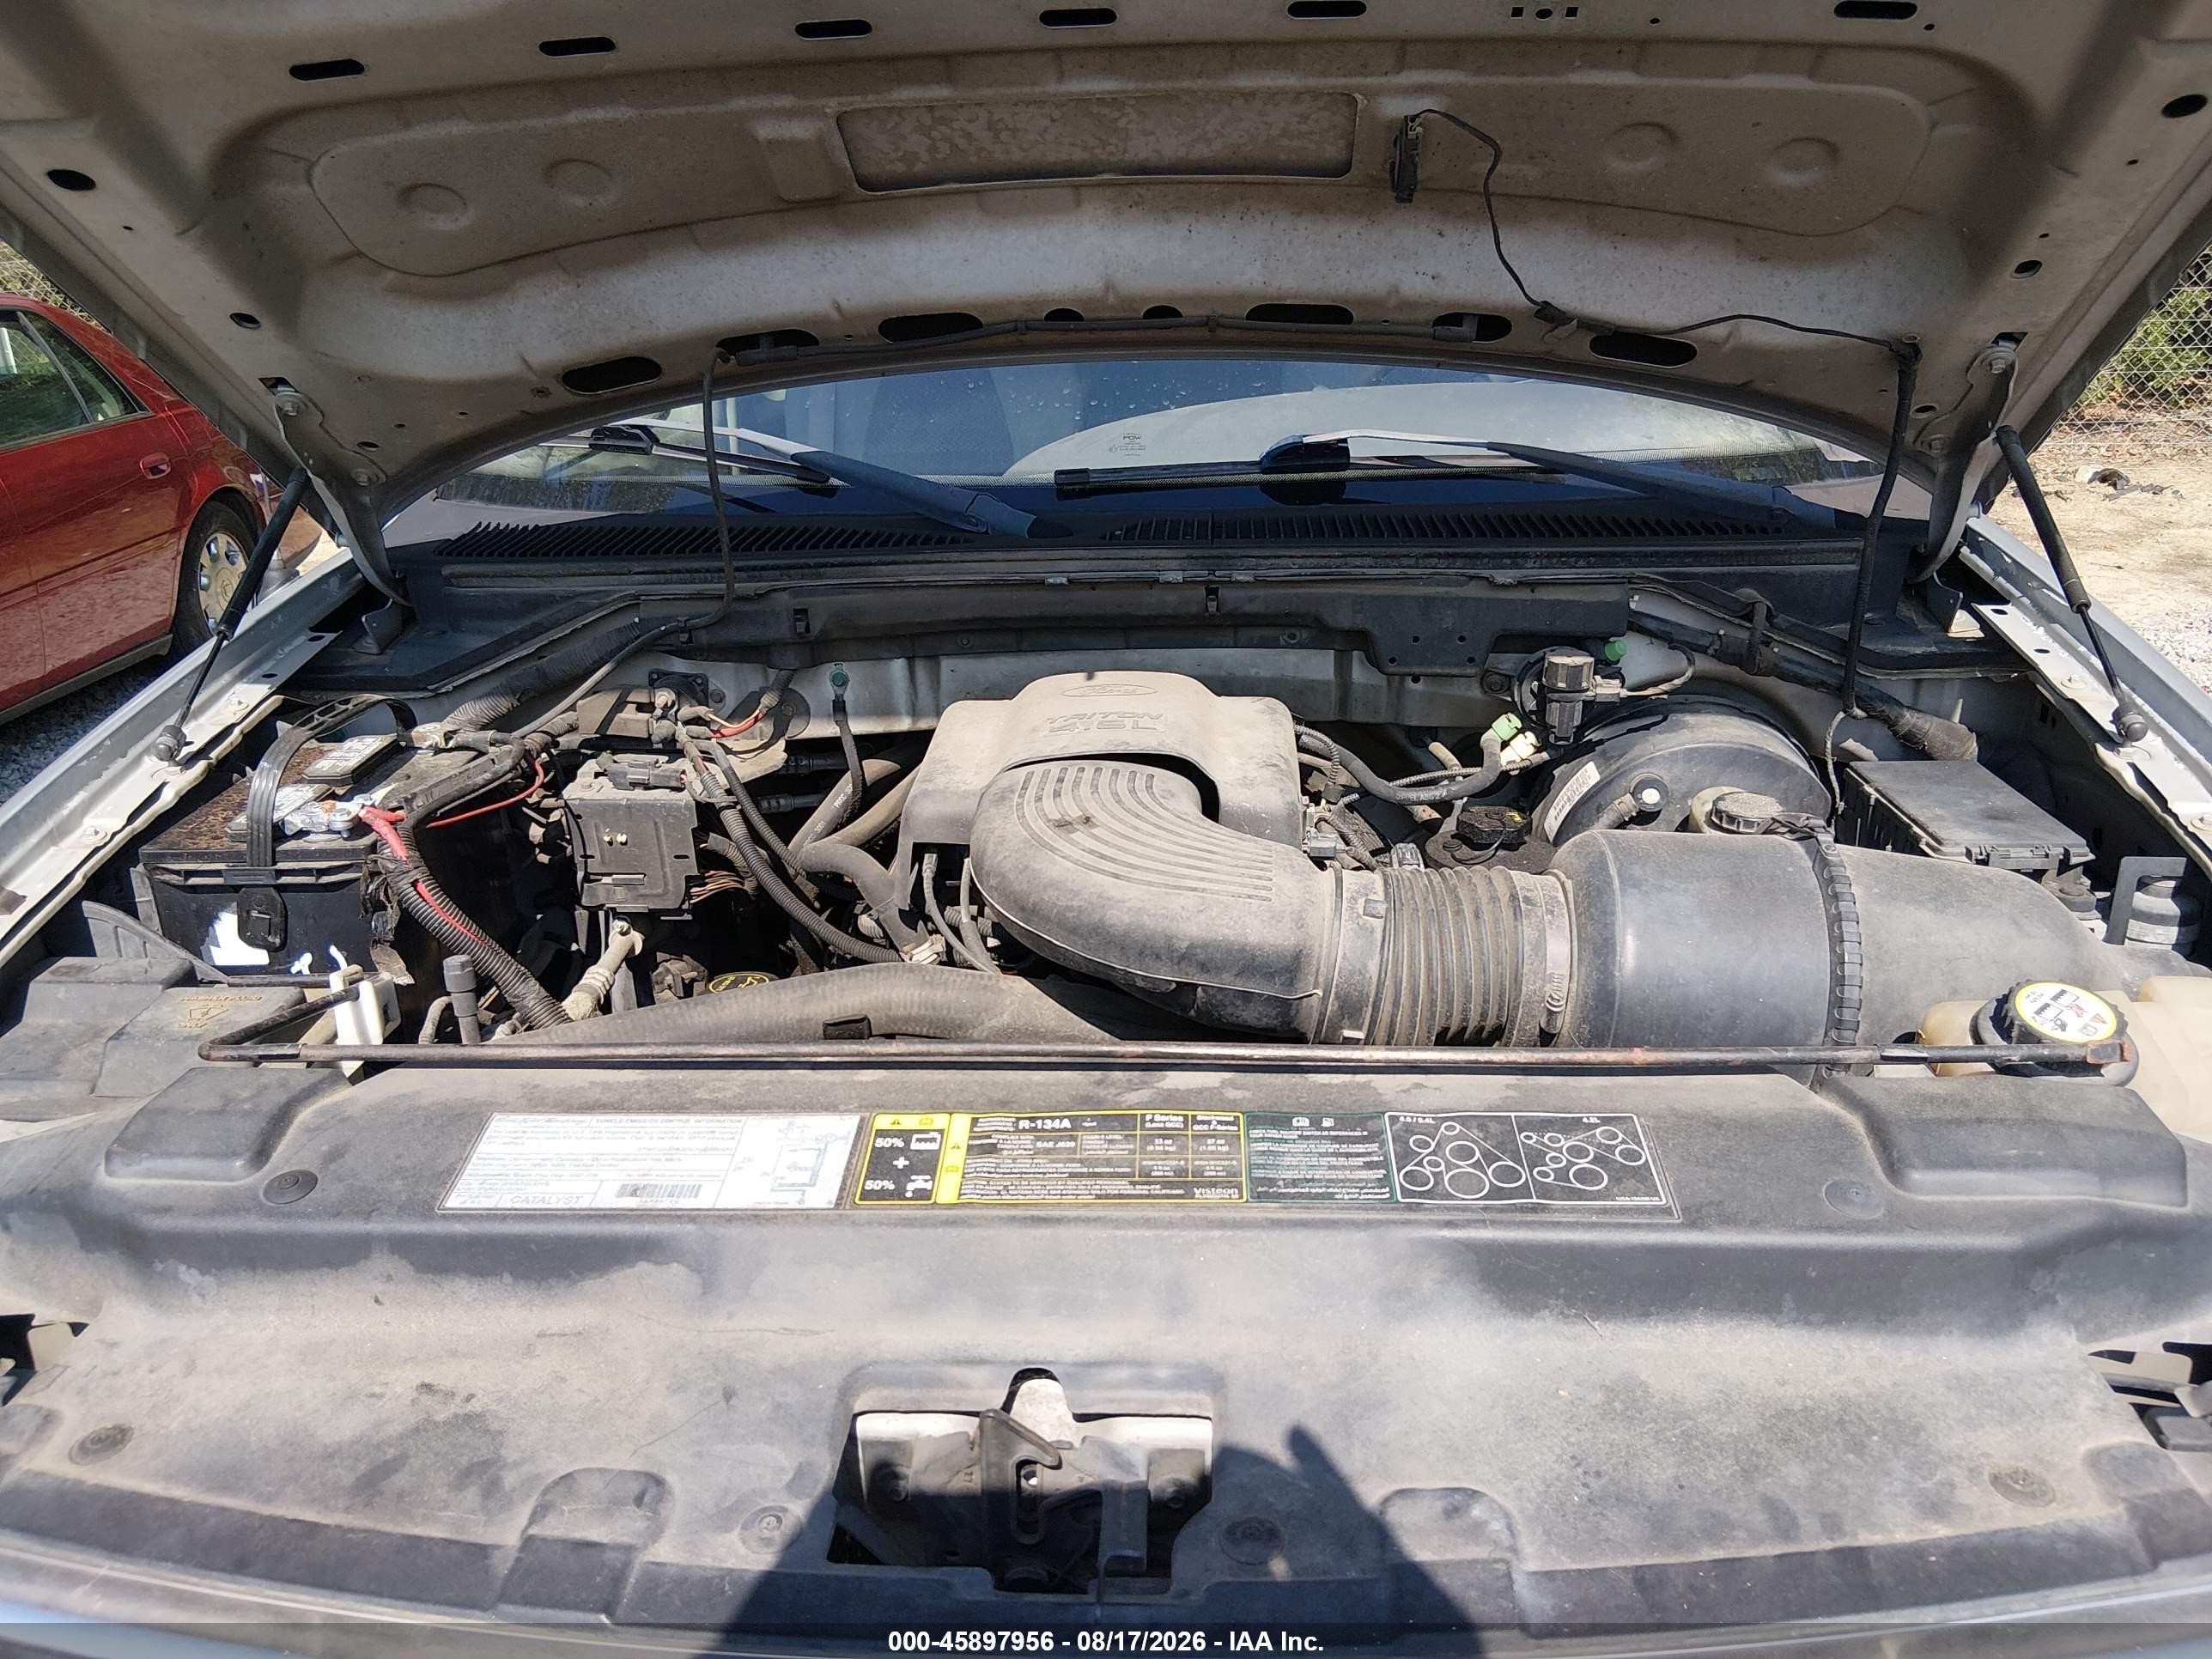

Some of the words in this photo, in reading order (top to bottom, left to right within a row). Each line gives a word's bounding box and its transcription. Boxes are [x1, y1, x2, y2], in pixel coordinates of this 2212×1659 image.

[1046, 711, 1164, 724] TRITON
[1048, 720, 1163, 733] 4.6L
[1153, 1114, 1184, 1122] Series
[1018, 1118, 1073, 1131] R-134A
[873, 1137, 906, 1149] 50%
[863, 1179, 896, 1191] 50%
[510, 1195, 586, 1206] CATALYST
